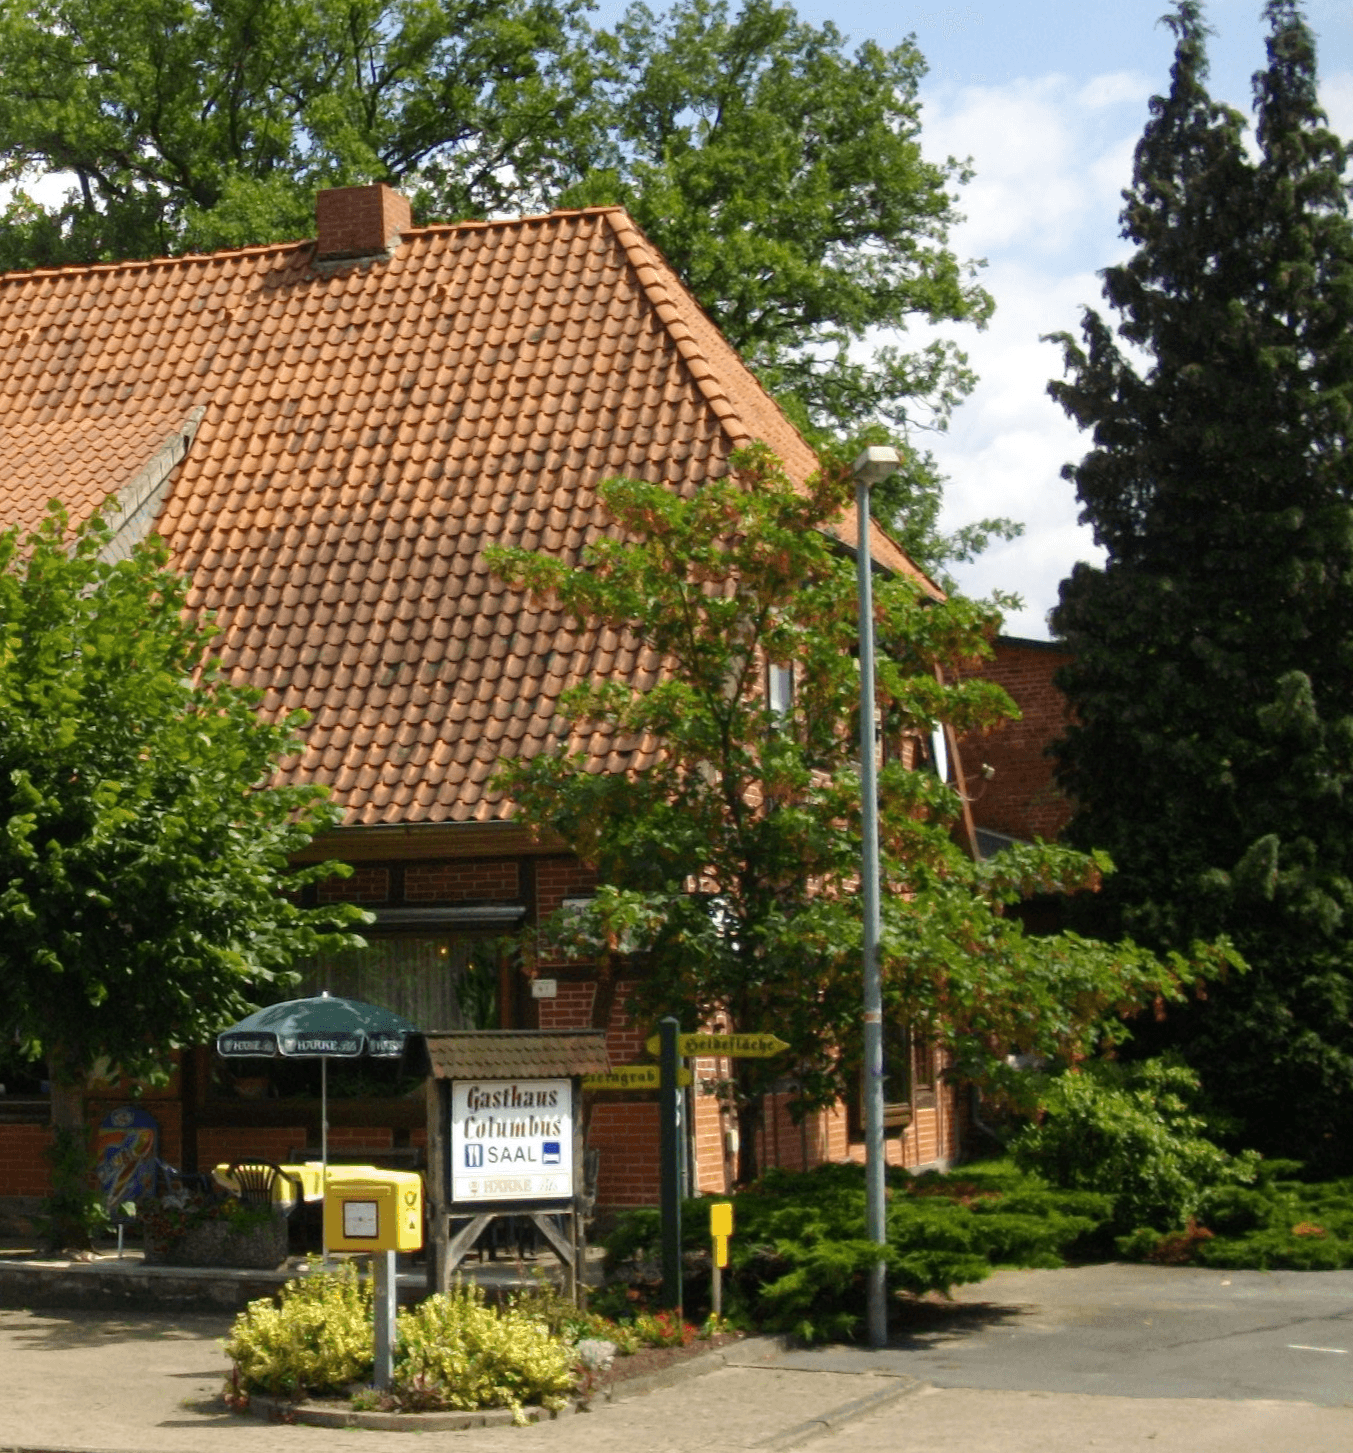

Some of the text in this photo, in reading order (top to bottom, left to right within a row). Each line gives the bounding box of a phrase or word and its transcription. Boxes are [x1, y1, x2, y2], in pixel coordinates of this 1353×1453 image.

[685, 1036, 774, 1052] Heidefläche
[467, 1085, 558, 1112] Gasthaus
[464, 1115, 561, 1139] Columbus
[487, 1146, 537, 1163] SAAL
